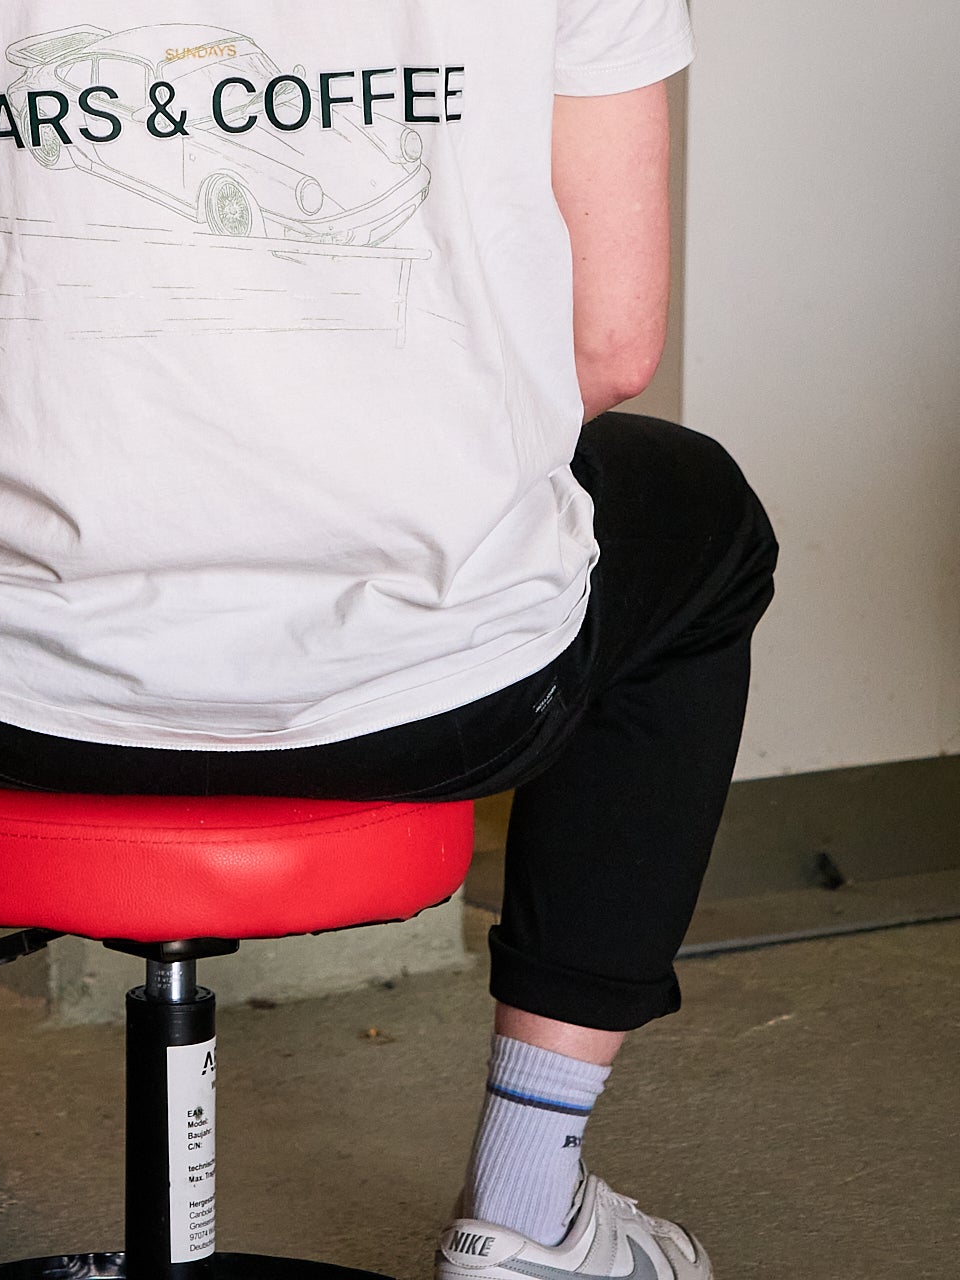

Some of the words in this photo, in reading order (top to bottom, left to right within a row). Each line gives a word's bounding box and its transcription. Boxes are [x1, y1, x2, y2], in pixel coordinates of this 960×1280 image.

[165, 44, 237, 62] SUNDAYS
[146, 80, 191, 139] &
[212, 66, 465, 134] COFFEE
[448, 1230, 496, 1257] NIKE
